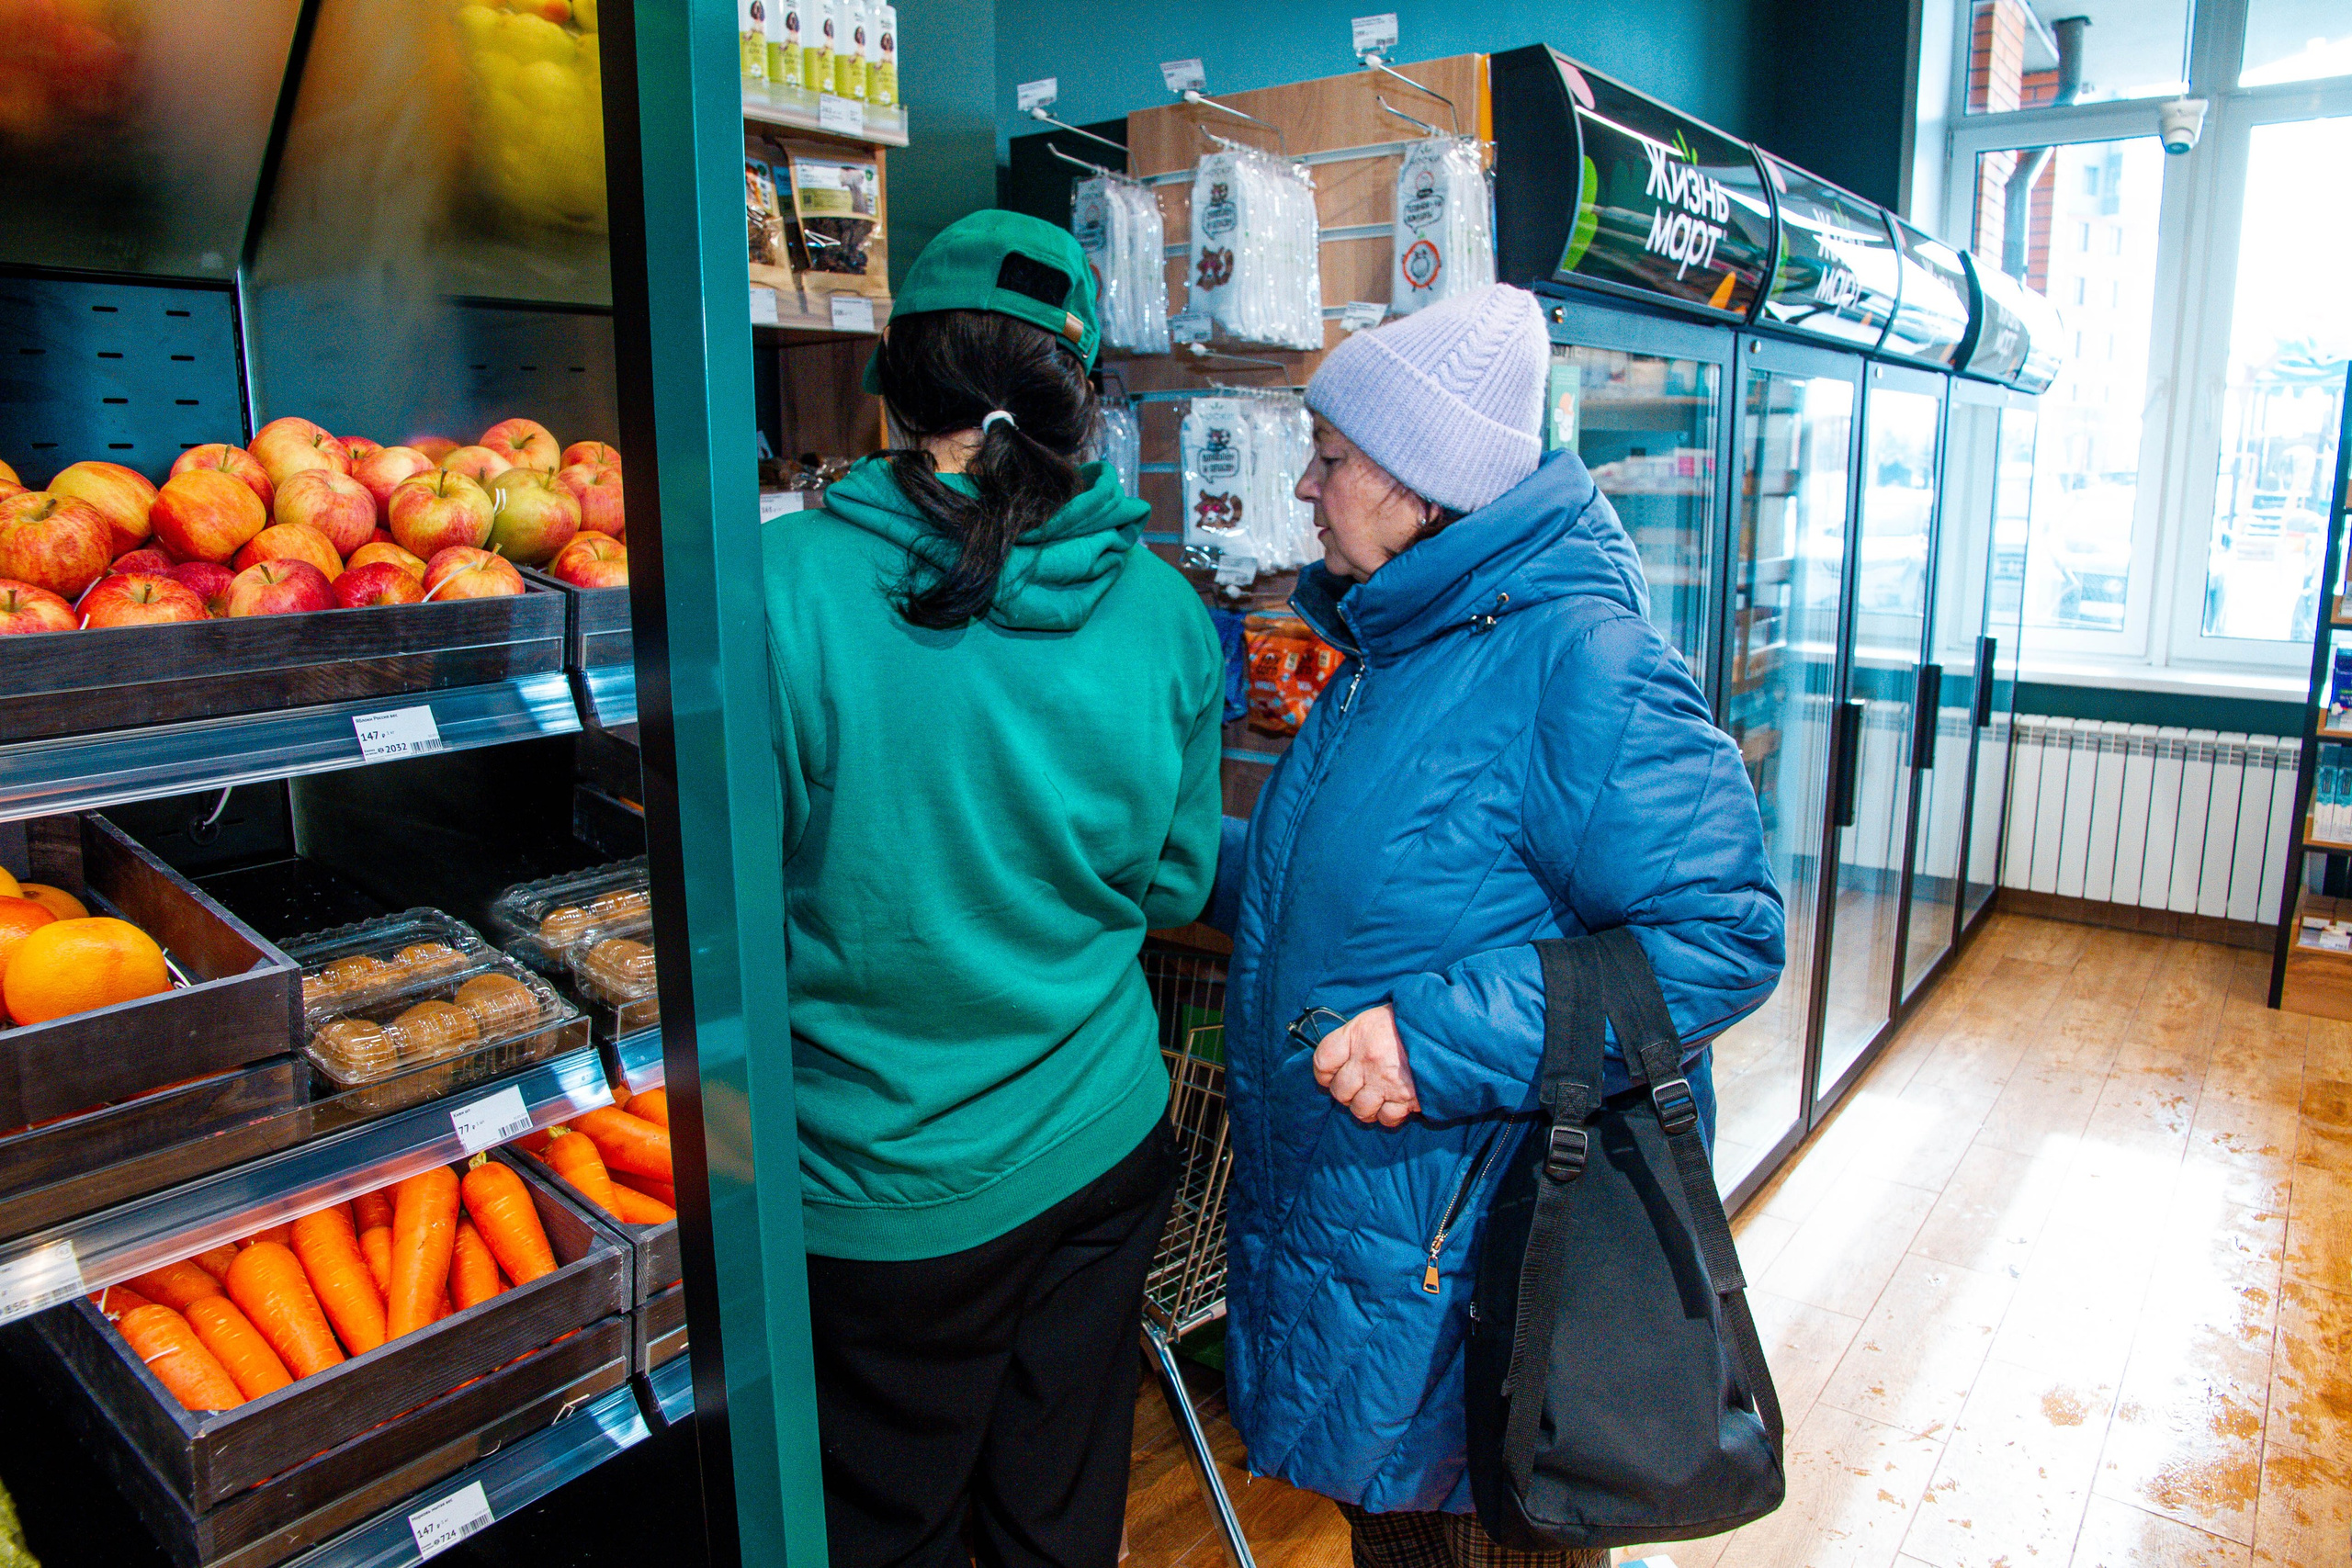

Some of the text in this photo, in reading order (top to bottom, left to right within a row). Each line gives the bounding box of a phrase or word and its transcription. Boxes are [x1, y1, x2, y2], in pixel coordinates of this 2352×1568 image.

[360, 731, 379, 742] 147
[385, 742, 408, 753] 2032
[458, 1123, 469, 1134] 77
[416, 1523, 434, 1540] 147
[440, 1529, 457, 1543] 724
